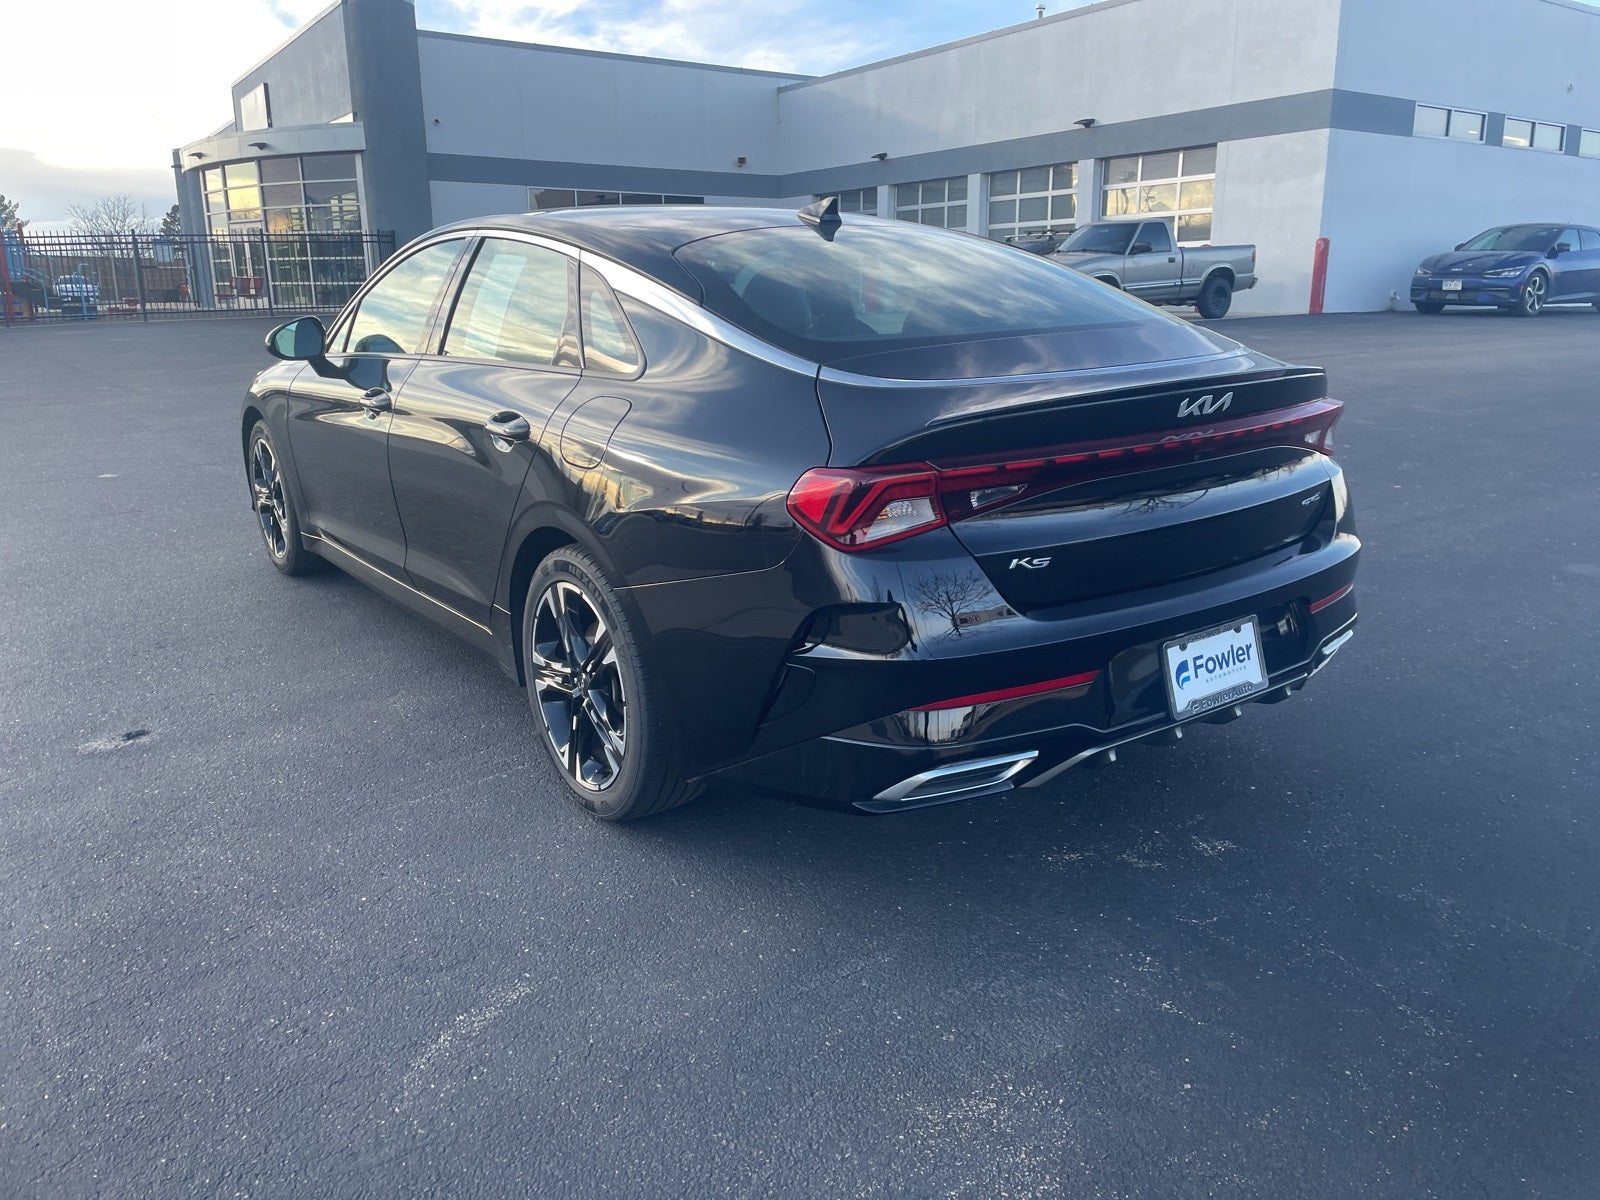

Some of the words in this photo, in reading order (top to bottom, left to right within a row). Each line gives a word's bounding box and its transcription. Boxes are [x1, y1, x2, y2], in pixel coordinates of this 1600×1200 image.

[1177, 392, 1233, 418] KIA
[1009, 556, 1053, 570] K5
[1192, 643, 1252, 679] Fowler
[1206, 665, 1247, 683] AUTOMOTIVE
